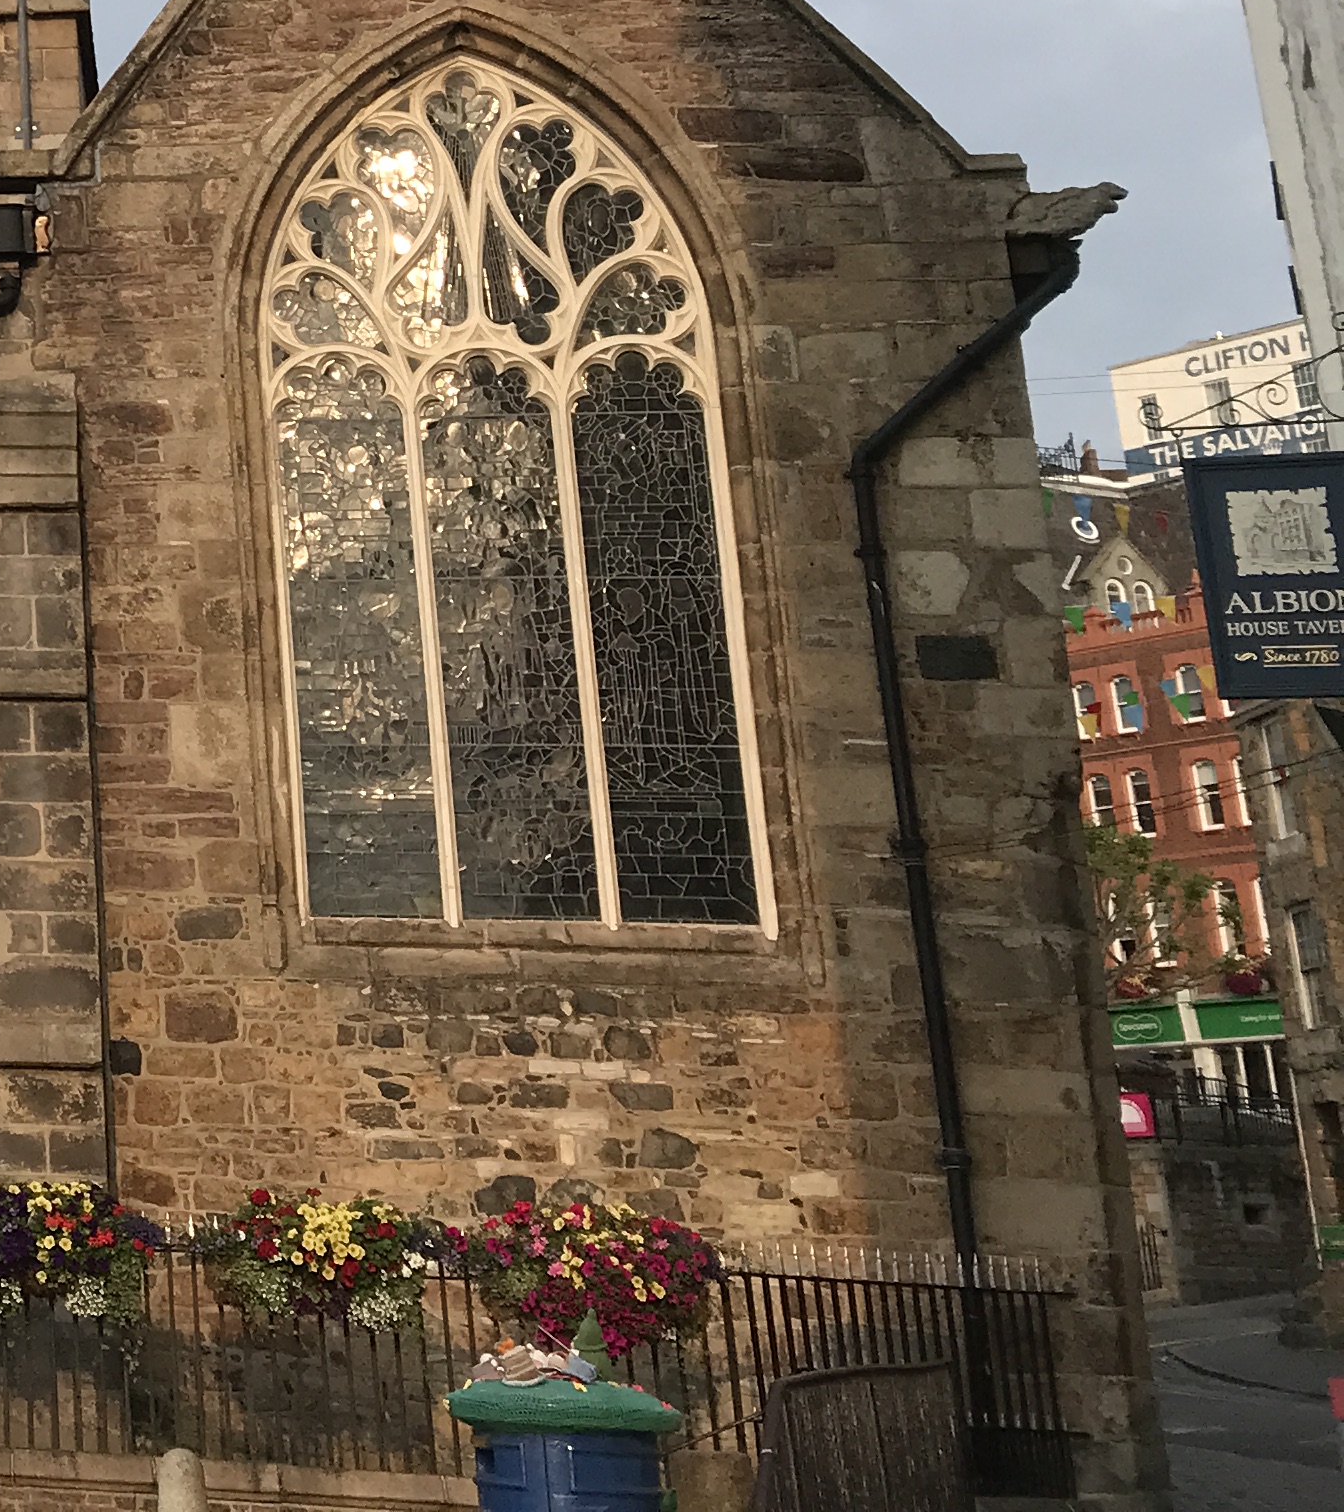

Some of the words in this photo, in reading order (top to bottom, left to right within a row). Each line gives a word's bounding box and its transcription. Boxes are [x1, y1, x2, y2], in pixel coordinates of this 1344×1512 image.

[1184, 334, 1290, 377] CLIFTON
[1148, 440, 1197, 466] THE
[1226, 621, 1290, 637] HOUSE
[1263, 649, 1302, 663] Since
[1304, 649, 1341, 665] 1780
